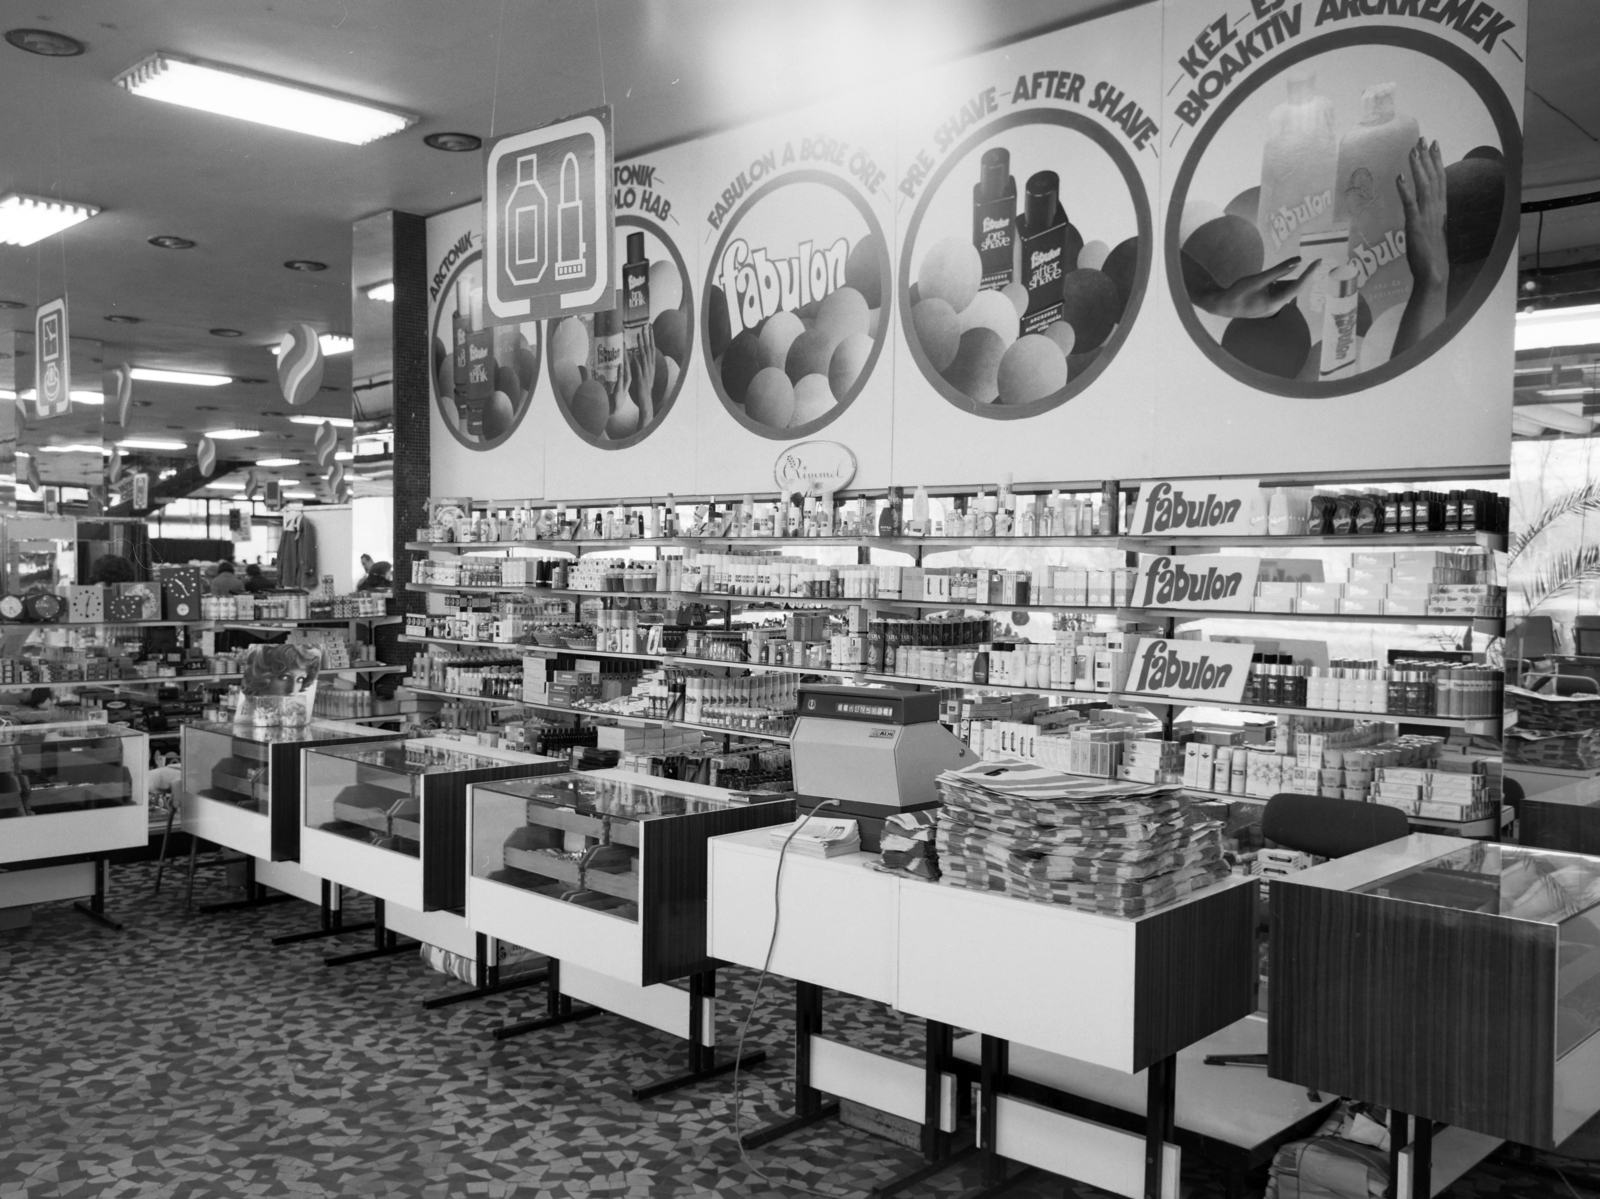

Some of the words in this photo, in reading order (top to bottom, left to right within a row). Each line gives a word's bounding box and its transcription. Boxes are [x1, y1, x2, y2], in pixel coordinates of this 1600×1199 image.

[1174, 2, 1302, 128] BIOAKTÍV
[899, 149, 935, 200] PRE
[933, 86, 999, 153] SHAVE
[1011, 70, 1085, 104] AFTER
[1088, 81, 1159, 152] SHAVE
[639, 189, 671, 221] HAB
[707, 149, 776, 230] FABULON
[781, 142, 795, 167] A
[429, 231, 474, 302] ARCTONIK
[719, 237, 850, 340] fabulon
[1141, 482, 1242, 534] fabulon
[1142, 556, 1243, 607] fabulon
[1135, 640, 1233, 692] fabulon
